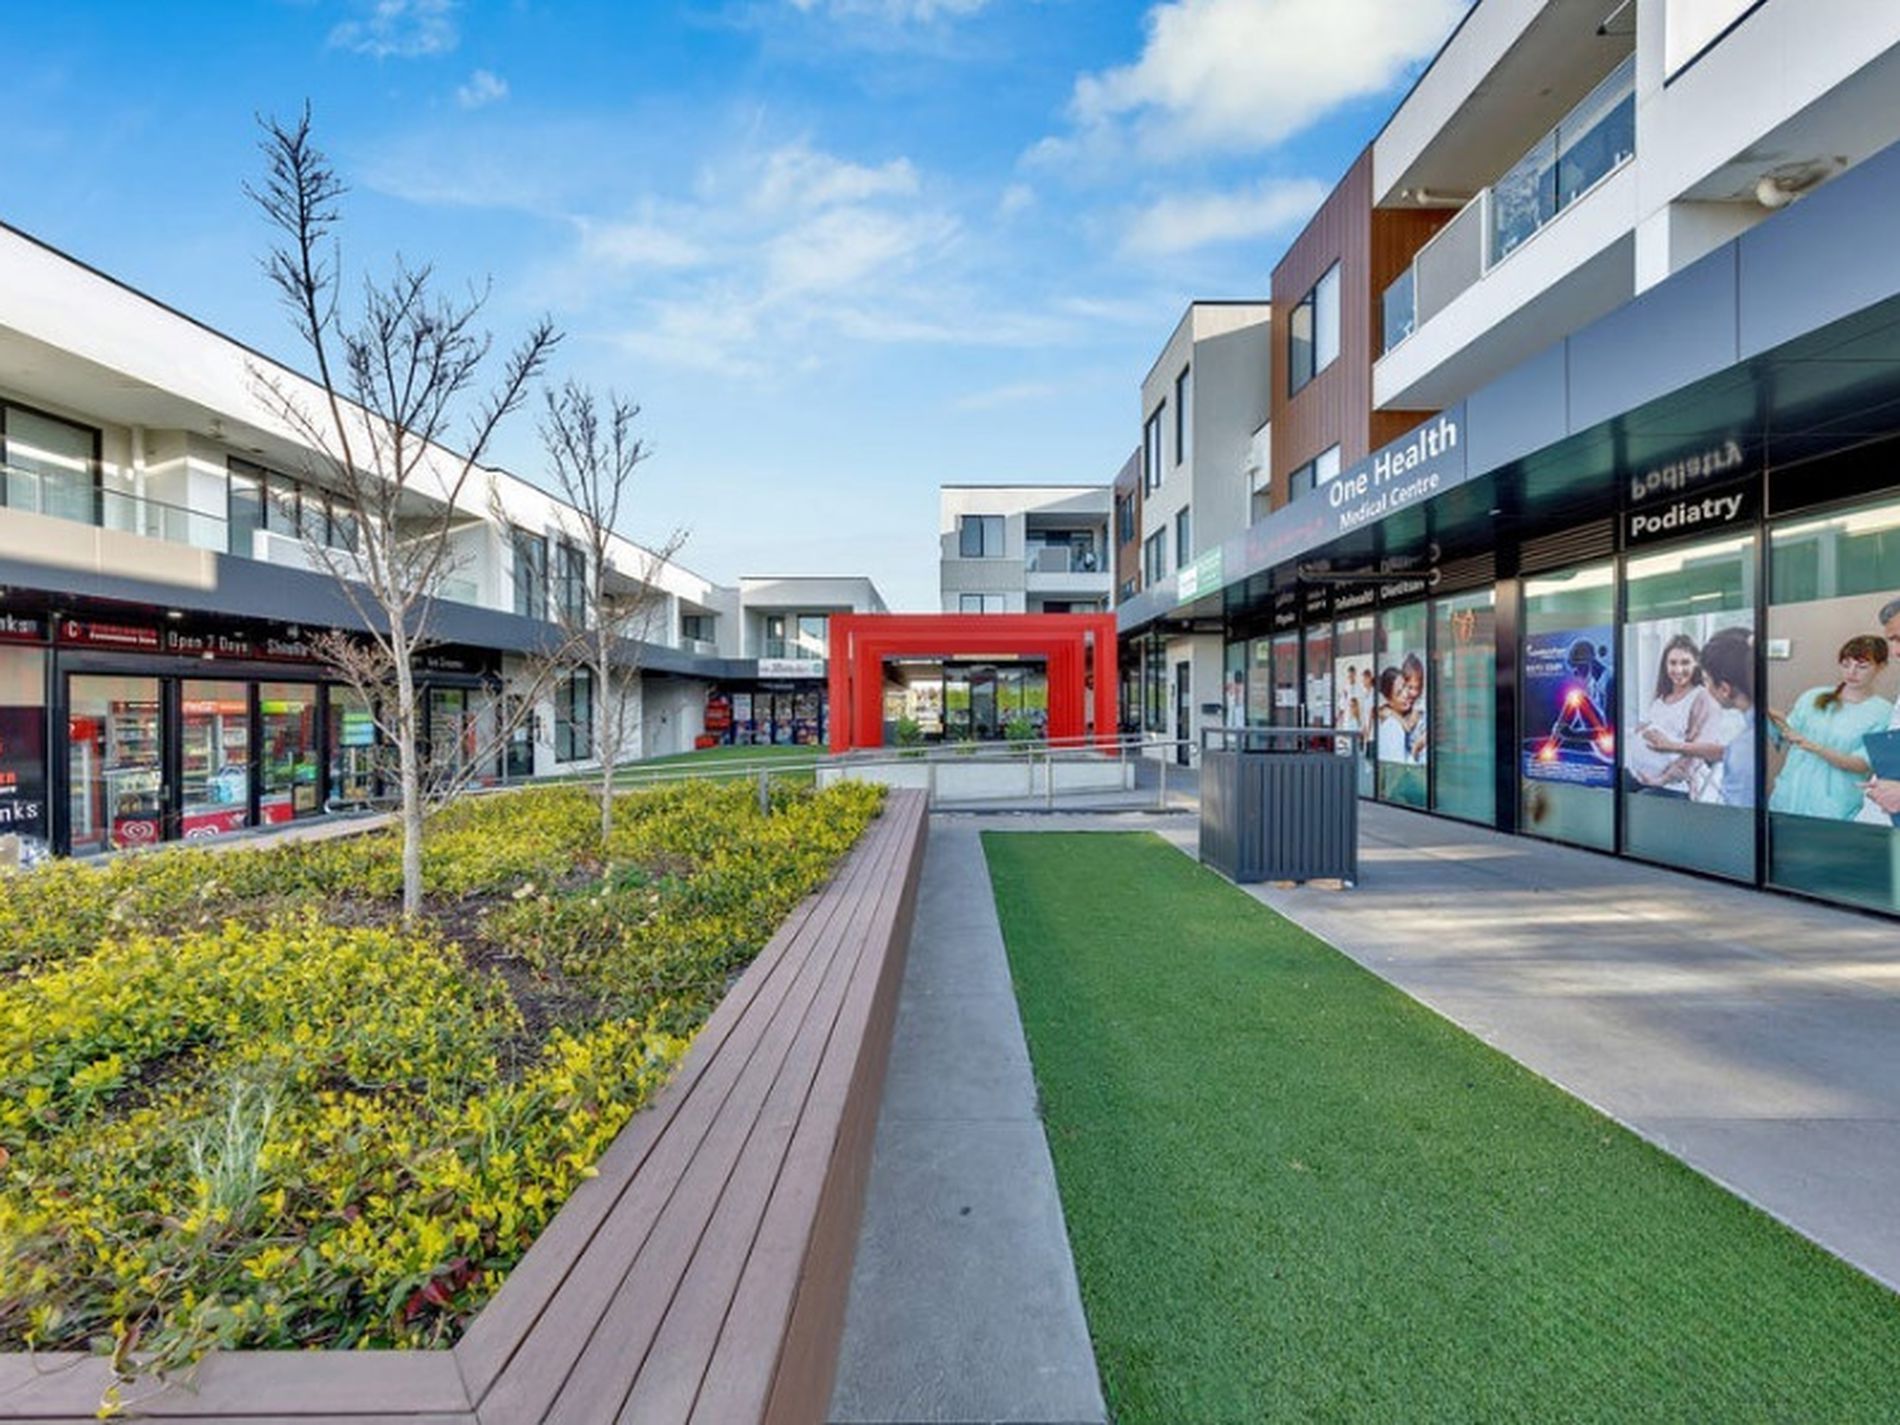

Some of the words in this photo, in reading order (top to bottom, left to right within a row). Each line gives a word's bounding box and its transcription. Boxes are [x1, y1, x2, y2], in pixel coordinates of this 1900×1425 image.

[1329, 473, 1368, 507] One
[1374, 417, 1457, 486] Health
[1338, 493, 1388, 531] Medical
[1390, 473, 1440, 507] Centre
[1631, 493, 1743, 537] Podiatry
[168, 631, 202, 650] Open
[207, 634, 215, 647] 7
[219, 636, 249, 654] Days
